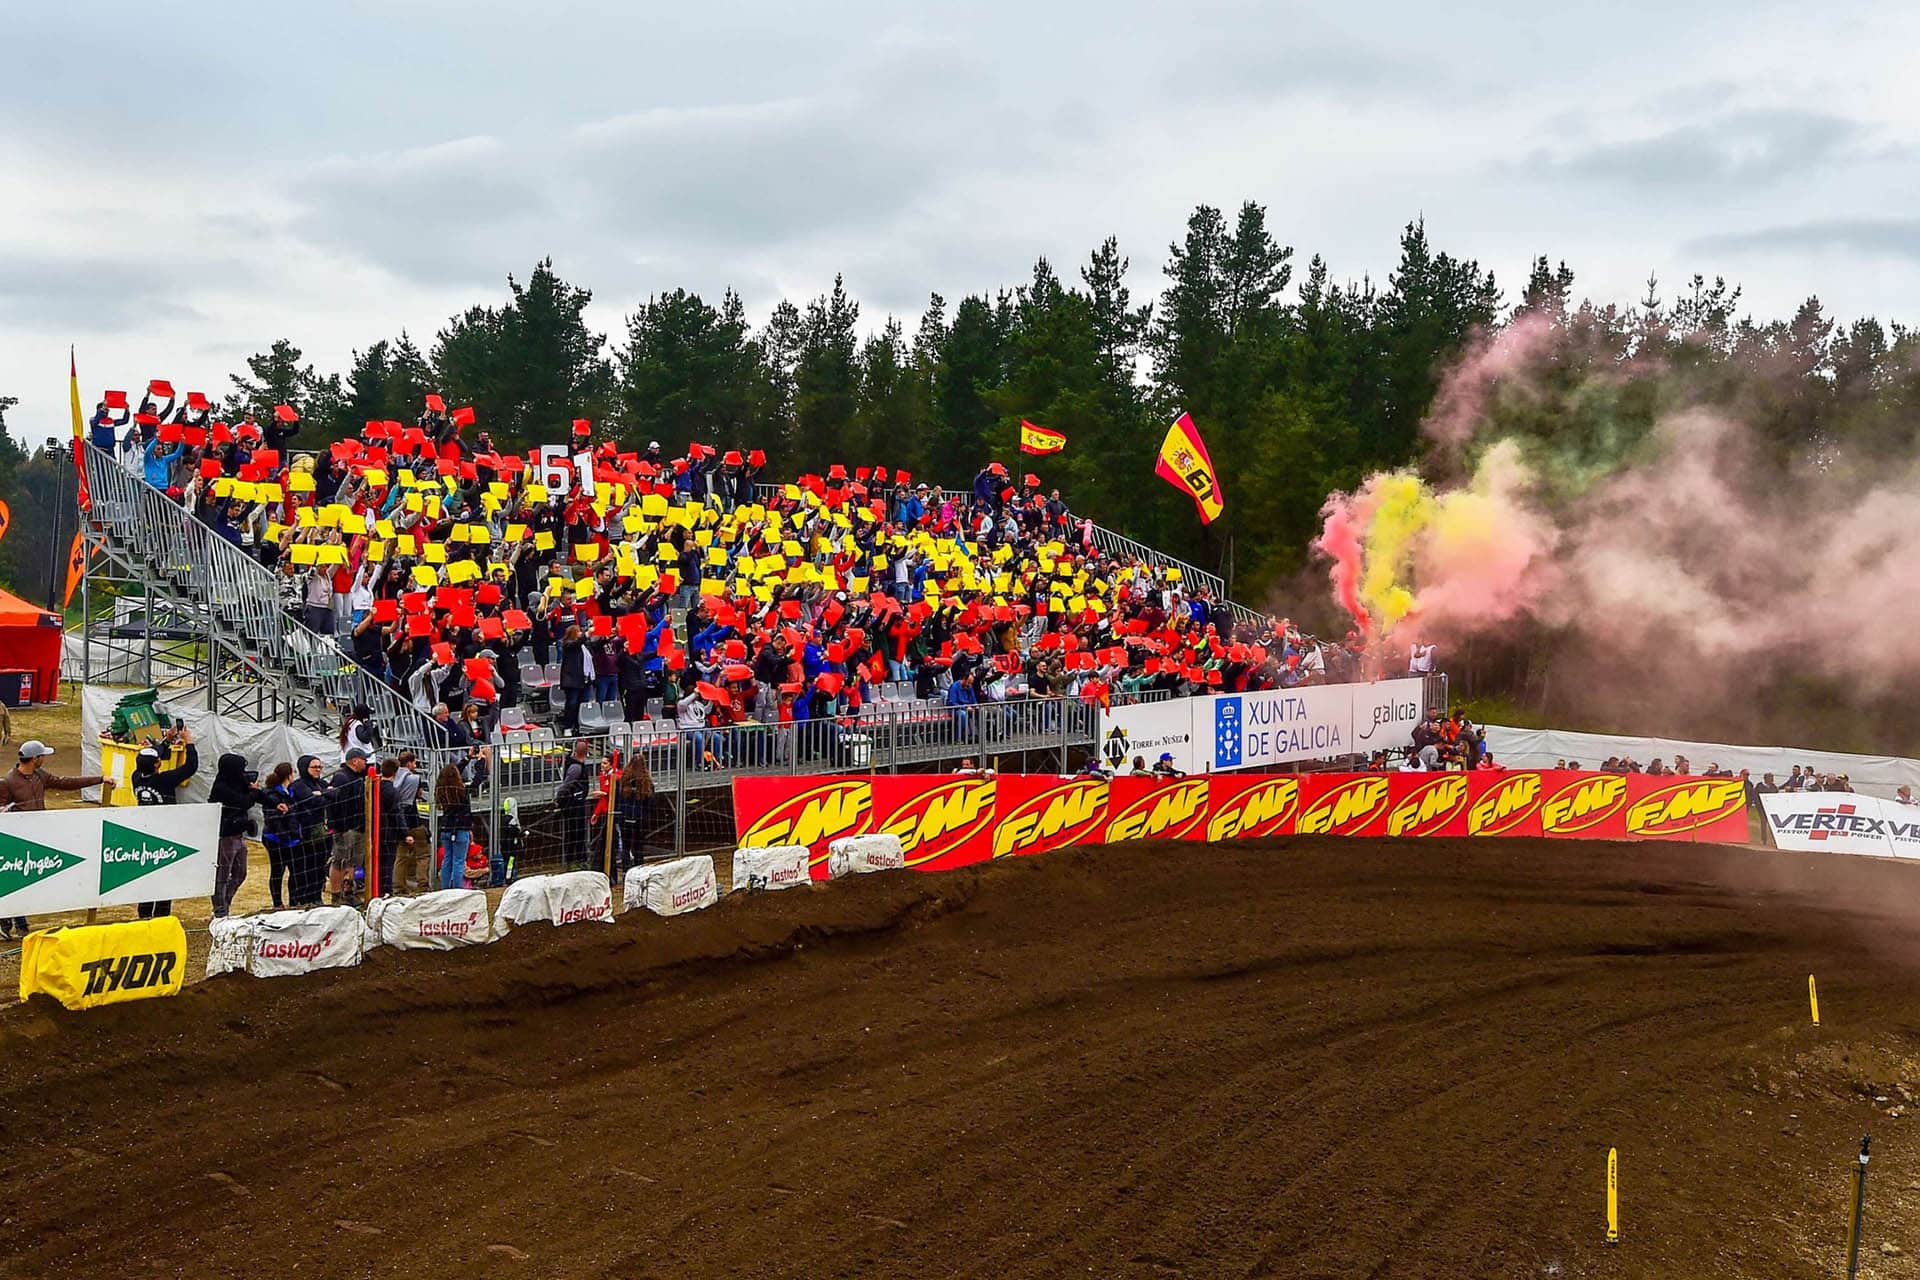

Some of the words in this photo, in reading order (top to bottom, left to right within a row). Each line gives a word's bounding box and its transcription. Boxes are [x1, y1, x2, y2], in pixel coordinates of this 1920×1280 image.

[541, 445, 594, 496] 61
[1249, 698, 1306, 725] XUNTA
[1359, 698, 1416, 739] galicia
[1248, 732, 1269, 757] DE
[1276, 725, 1341, 753] GALICIA
[993, 781, 1109, 859] FMF
[1106, 781, 1209, 844] FMF
[1208, 779, 1298, 843] FMF
[1302, 778, 1388, 834] FMF
[1388, 776, 1467, 837] FMF
[1469, 776, 1541, 836] FMF
[1543, 777, 1627, 831] FMF
[1627, 780, 1744, 833] FMF
[1770, 813, 1885, 835] VERTEX
[1851, 832, 1882, 840] POWER
[23, 850, 63, 876] Inglés
[103, 847, 114, 863] El
[115, 847, 140, 863] Corte
[140, 842, 177, 866] Inglés
[866, 852, 896, 867] lastlap
[771, 868, 798, 882] lastlap
[672, 887, 705, 909] lastlap
[419, 919, 469, 938] lastlap
[260, 939, 321, 961] lastlap
[80, 951, 177, 998] THOR
